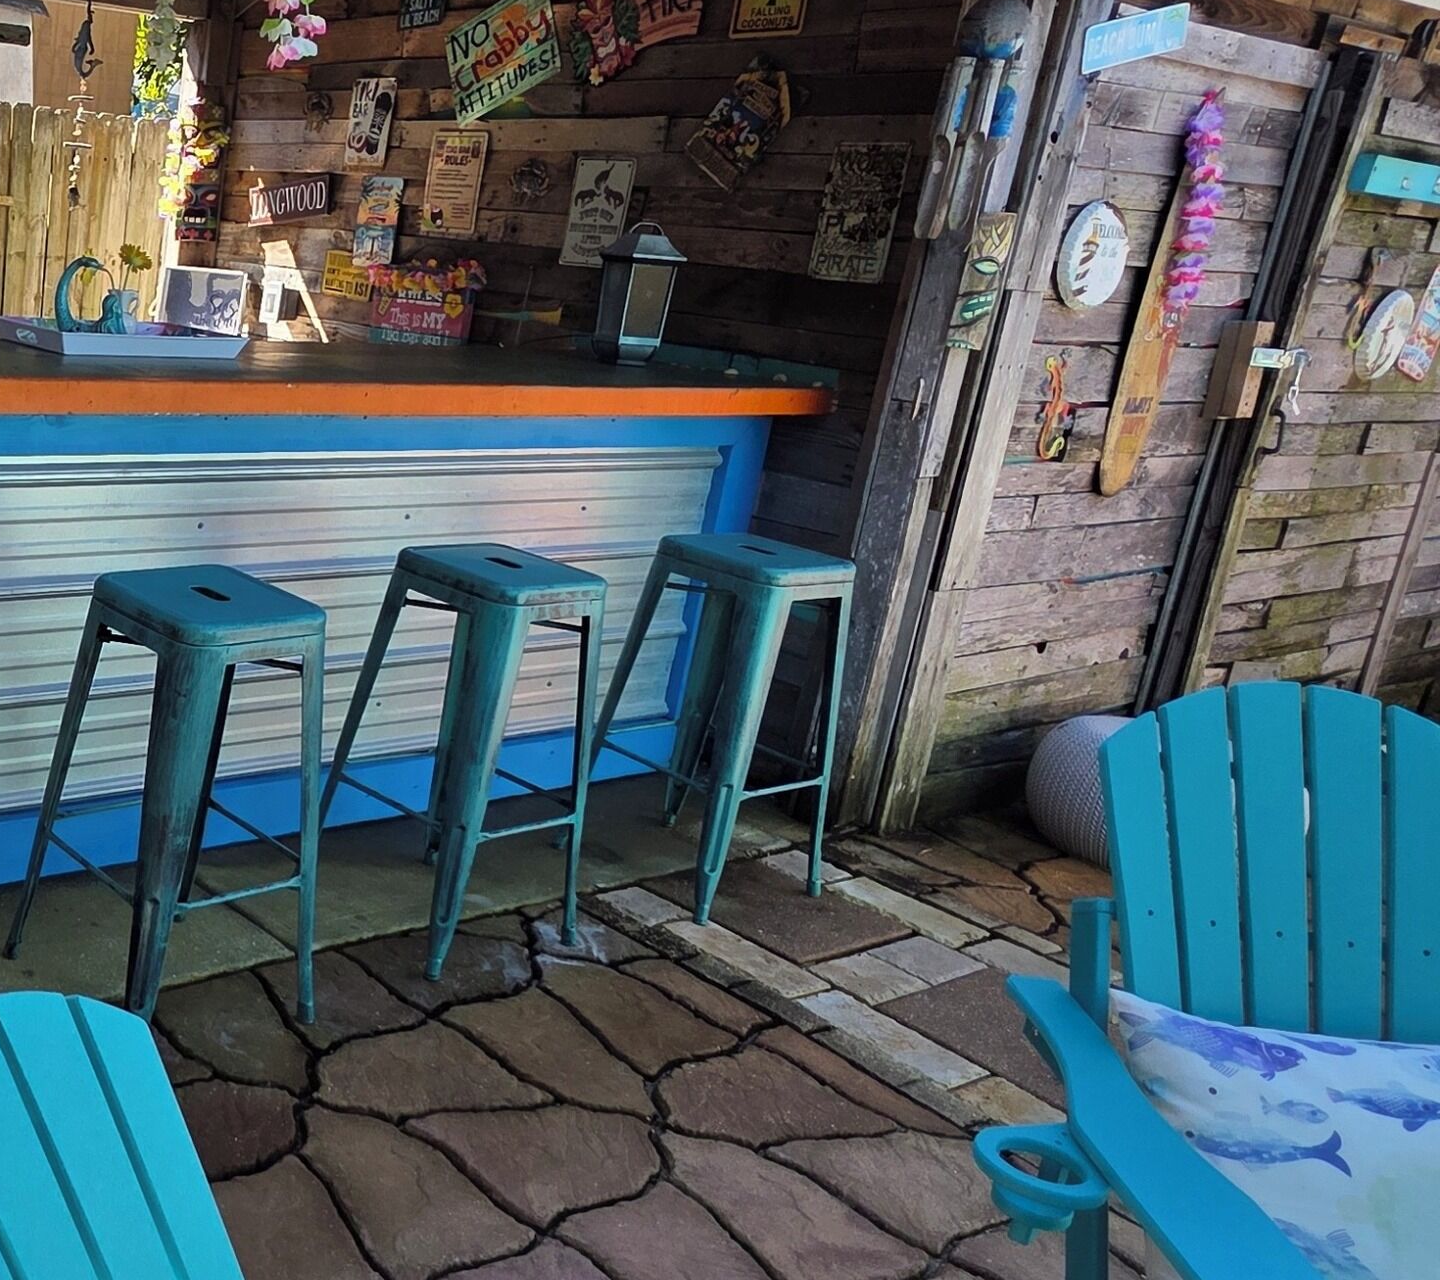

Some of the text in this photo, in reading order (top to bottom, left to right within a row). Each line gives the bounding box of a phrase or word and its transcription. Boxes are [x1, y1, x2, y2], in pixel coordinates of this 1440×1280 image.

[741, 16, 794, 28] COCONUTS
[750, 6, 791, 17] FALLING
[450, 20, 490, 65] NO
[455, 9, 552, 92] Crabby
[458, 43, 557, 116] ATTITUDES!
[250, 181, 326, 220] LONGWOOD
[814, 254, 877, 275] PIRATE
[390, 307, 410, 326] This
[422, 311, 446, 330] MY
